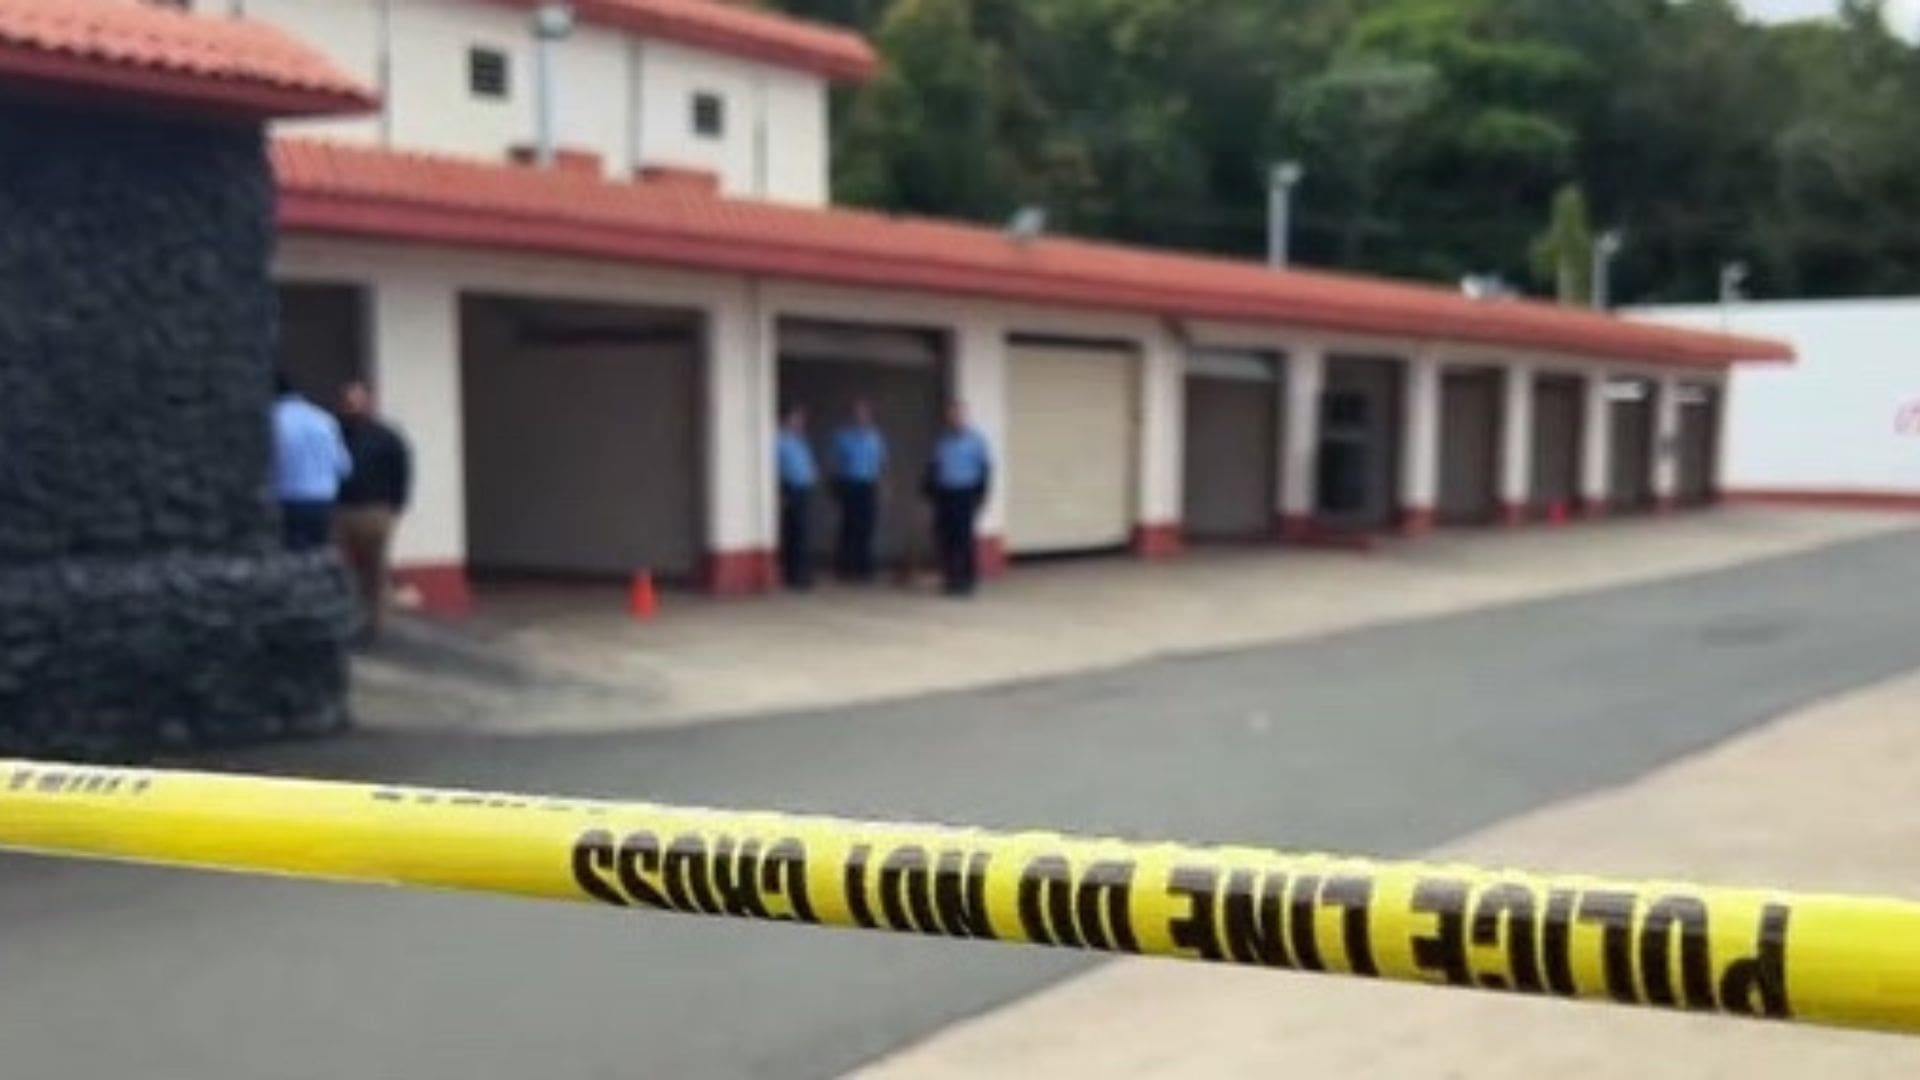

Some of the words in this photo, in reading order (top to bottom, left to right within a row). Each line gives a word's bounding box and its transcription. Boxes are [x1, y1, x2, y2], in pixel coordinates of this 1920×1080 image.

[571, 829, 822, 923] CROSS
[1018, 855, 1141, 954] DO
[1167, 866, 1377, 976] LINE
[1410, 879, 1790, 1018] POLICE
